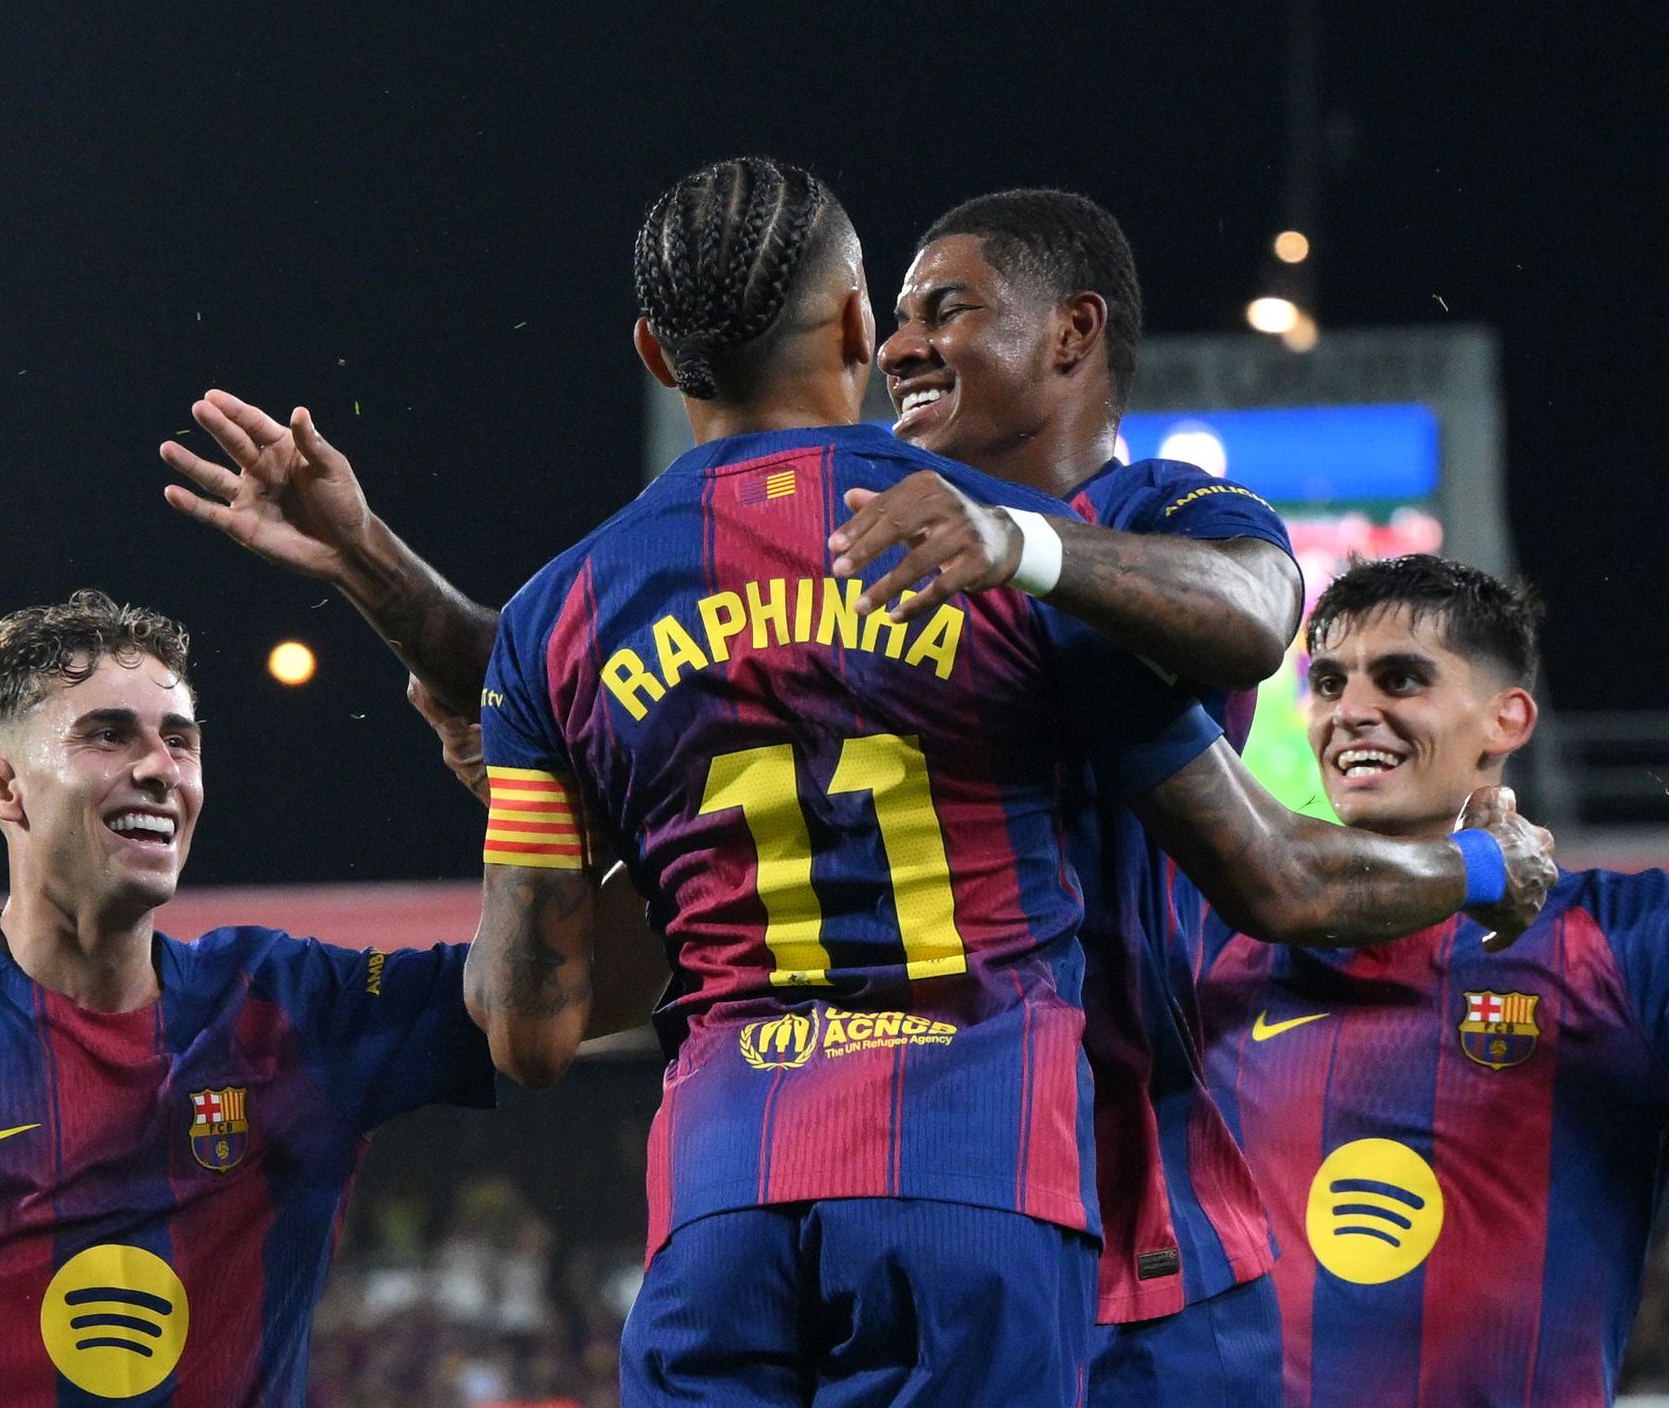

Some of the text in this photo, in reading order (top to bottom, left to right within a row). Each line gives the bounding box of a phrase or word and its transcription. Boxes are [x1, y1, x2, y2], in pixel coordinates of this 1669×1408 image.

[600, 578, 965, 721] RAPHINHA
[698, 733, 968, 987] 11
[825, 1034, 953, 1059] The UN Refugee Agency
